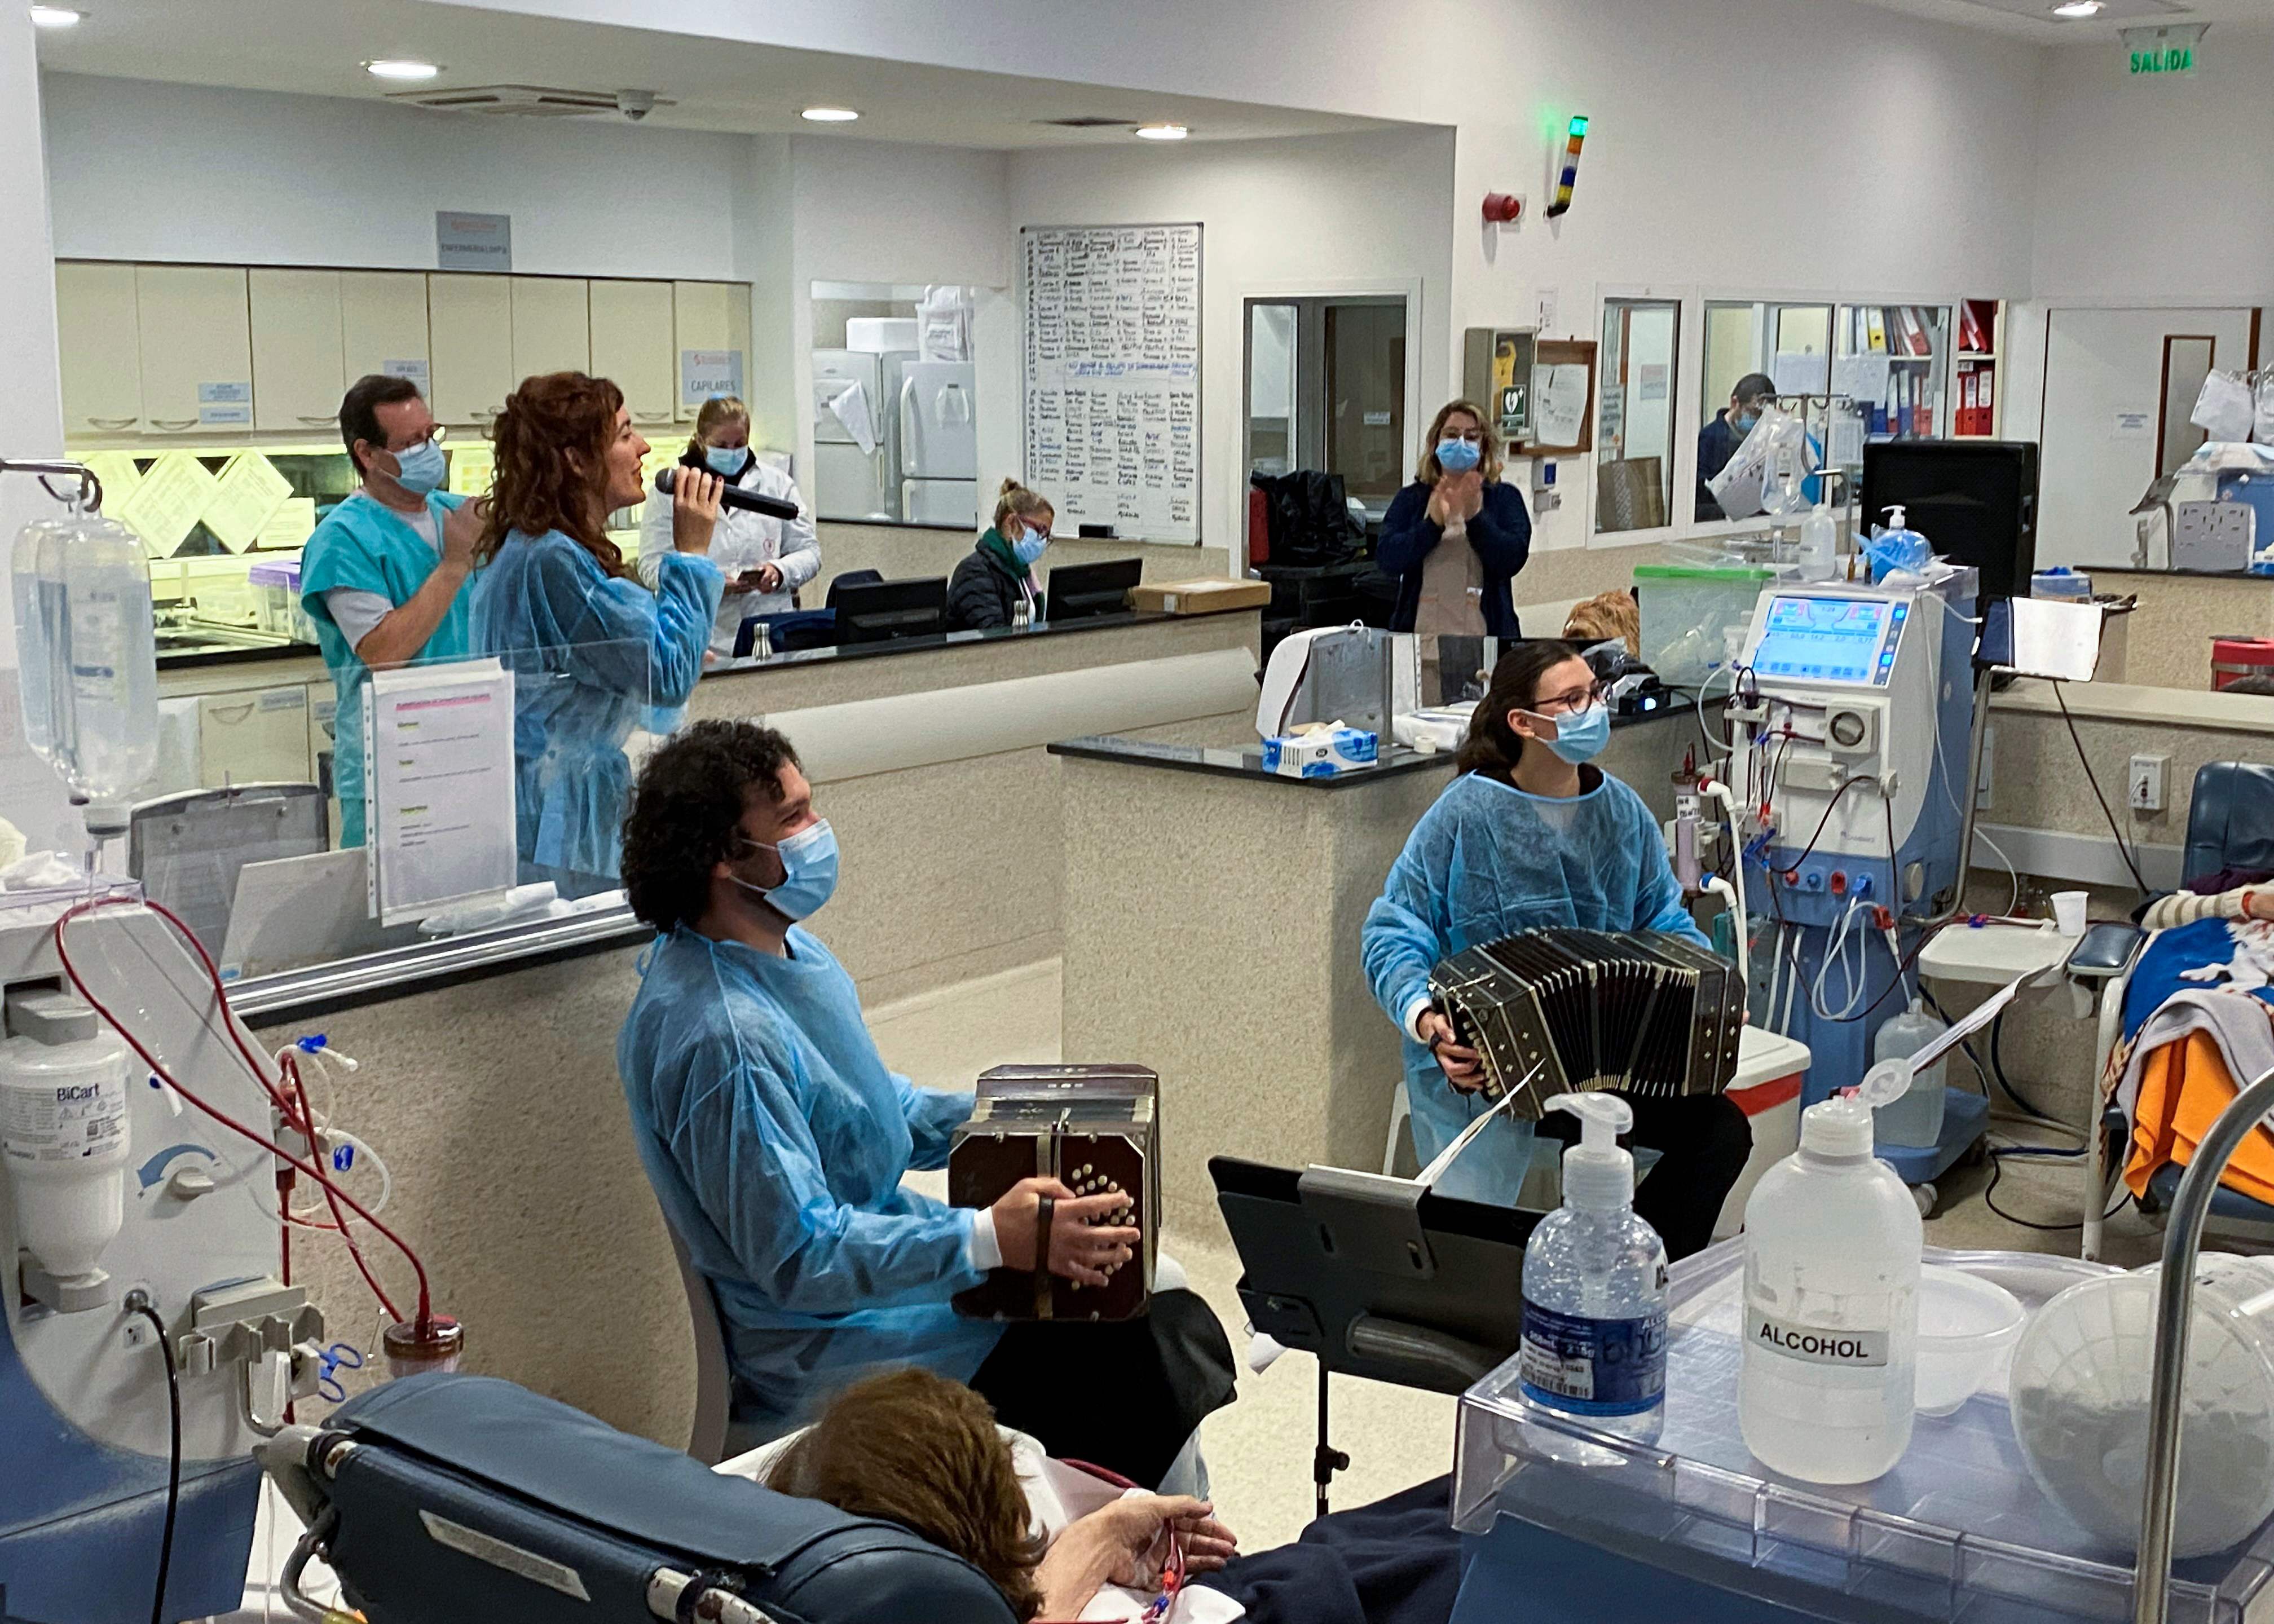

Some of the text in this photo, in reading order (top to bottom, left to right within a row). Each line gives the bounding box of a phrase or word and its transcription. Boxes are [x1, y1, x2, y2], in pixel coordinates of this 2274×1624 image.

[2130, 48, 2192, 74] SALIDA
[691, 379, 736, 392] CAPILARES
[57, 1082, 100, 1101] BiCart
[1760, 1322, 1869, 1358] ALCOHOL
